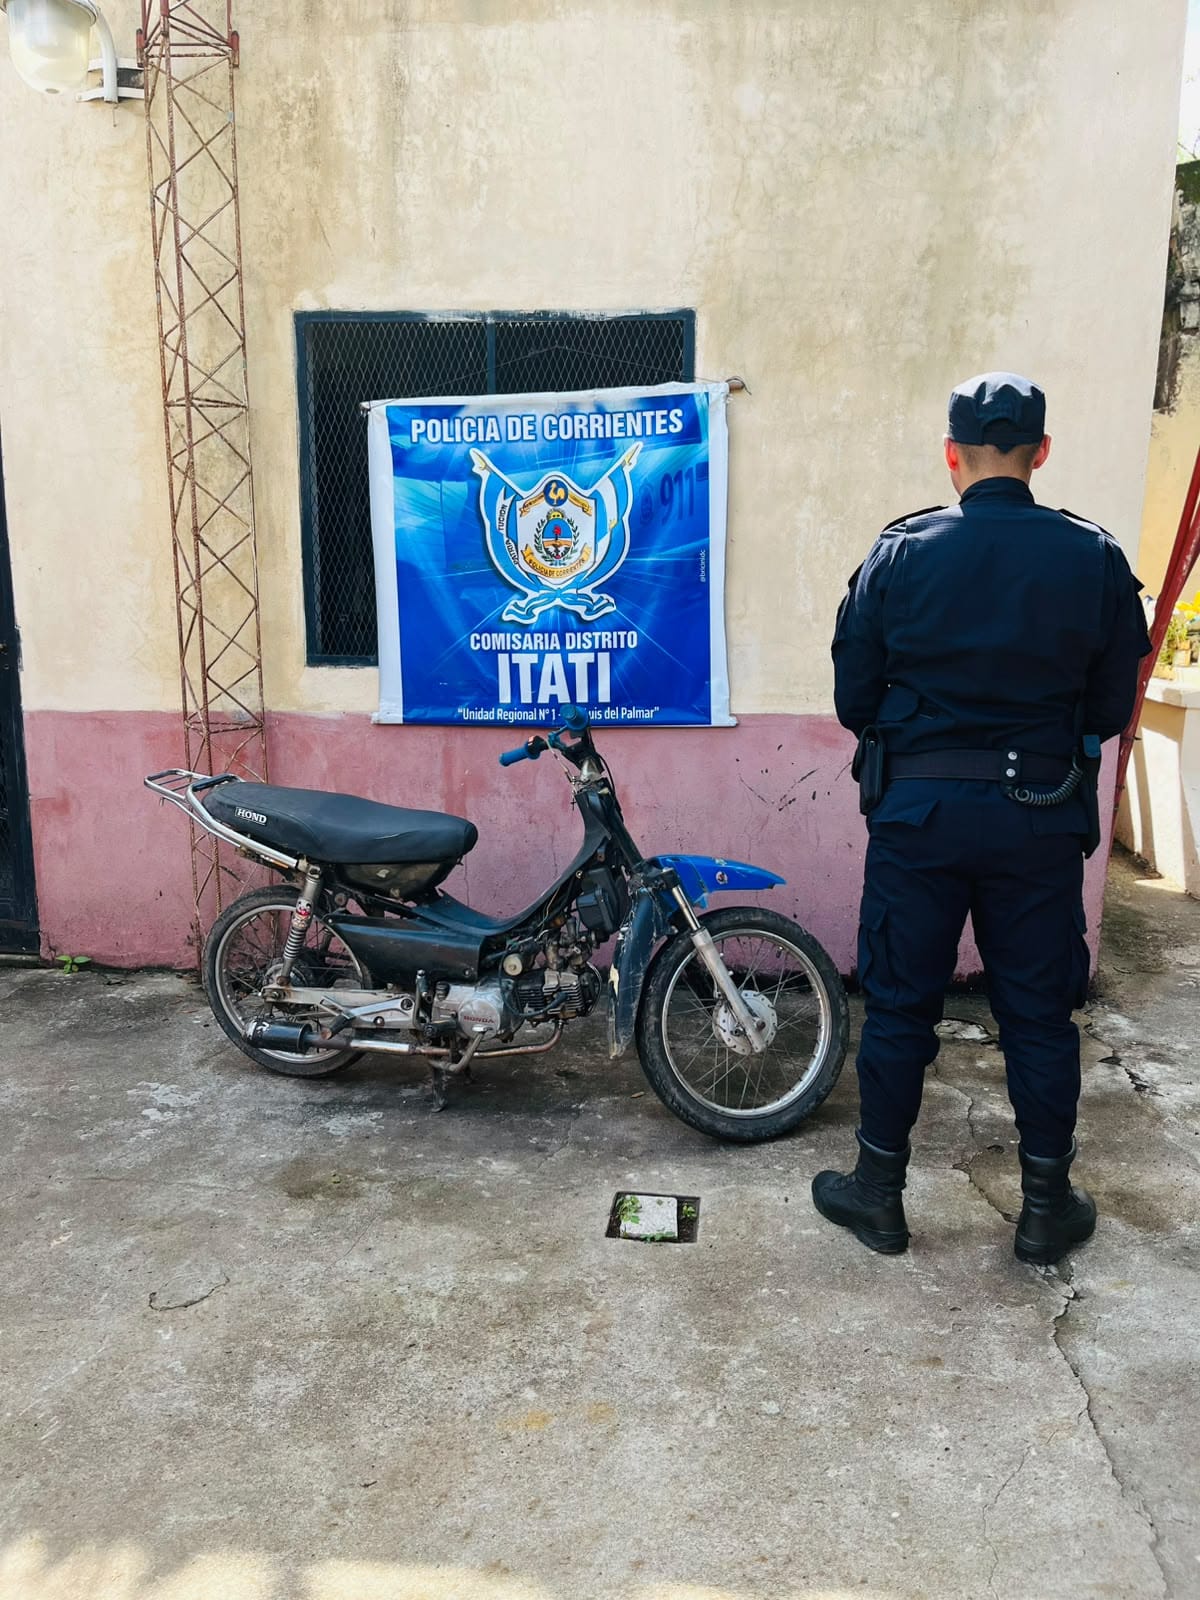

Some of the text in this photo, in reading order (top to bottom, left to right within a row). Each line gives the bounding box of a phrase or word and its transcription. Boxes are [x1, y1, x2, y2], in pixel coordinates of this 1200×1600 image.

[410, 409, 684, 443] POLICIA DE CORRIENTES
[660, 466, 695, 526] 911
[470, 631, 638, 651] COMISARIA DISTRITO
[497, 652, 611, 704] ITATI
[496, 708, 537, 723] Regional
[551, 709, 556, 720] 1
[584, 707, 602, 720] uis
[604, 707, 619, 719] del
